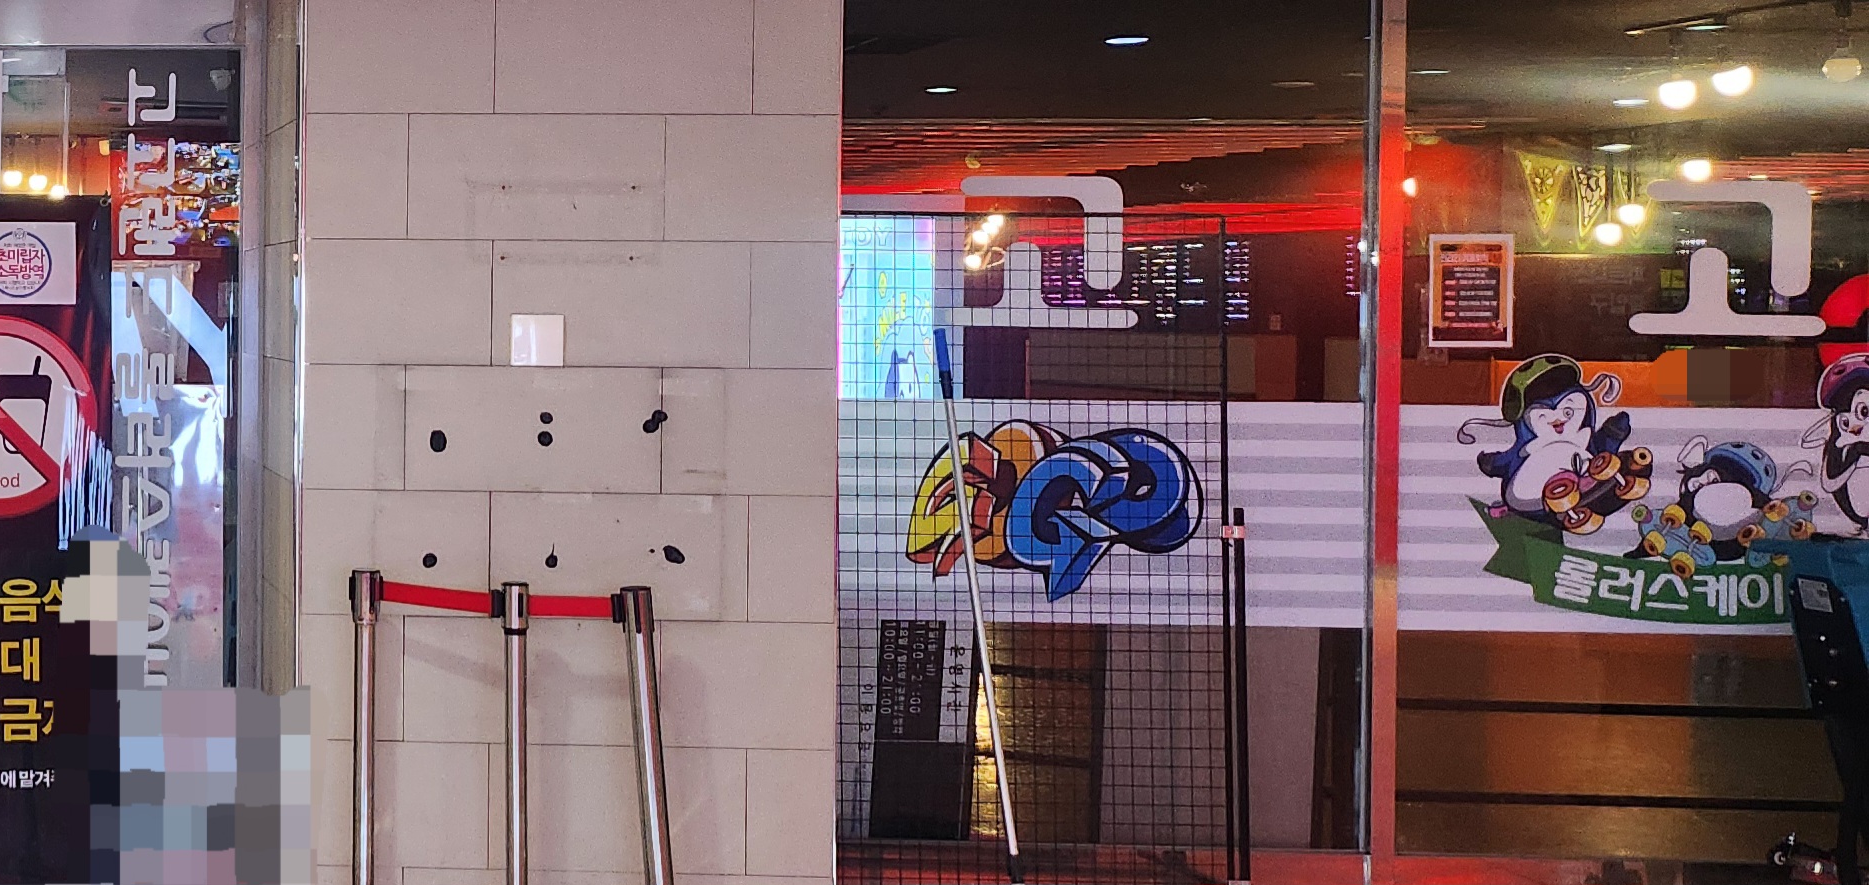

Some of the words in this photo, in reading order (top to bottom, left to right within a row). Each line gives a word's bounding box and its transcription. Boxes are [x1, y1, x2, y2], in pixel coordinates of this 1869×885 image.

[119, 67, 177, 319] 고고랜드
[934, 175, 1139, 330] 고
[1628, 180, 1828, 337] 고
[880, 675, 893, 715] 21:00
[909, 674, 923, 714] 2:00
[946, 646, 966, 713] 운영시간
[19, 769, 55, 788] 맡겨
